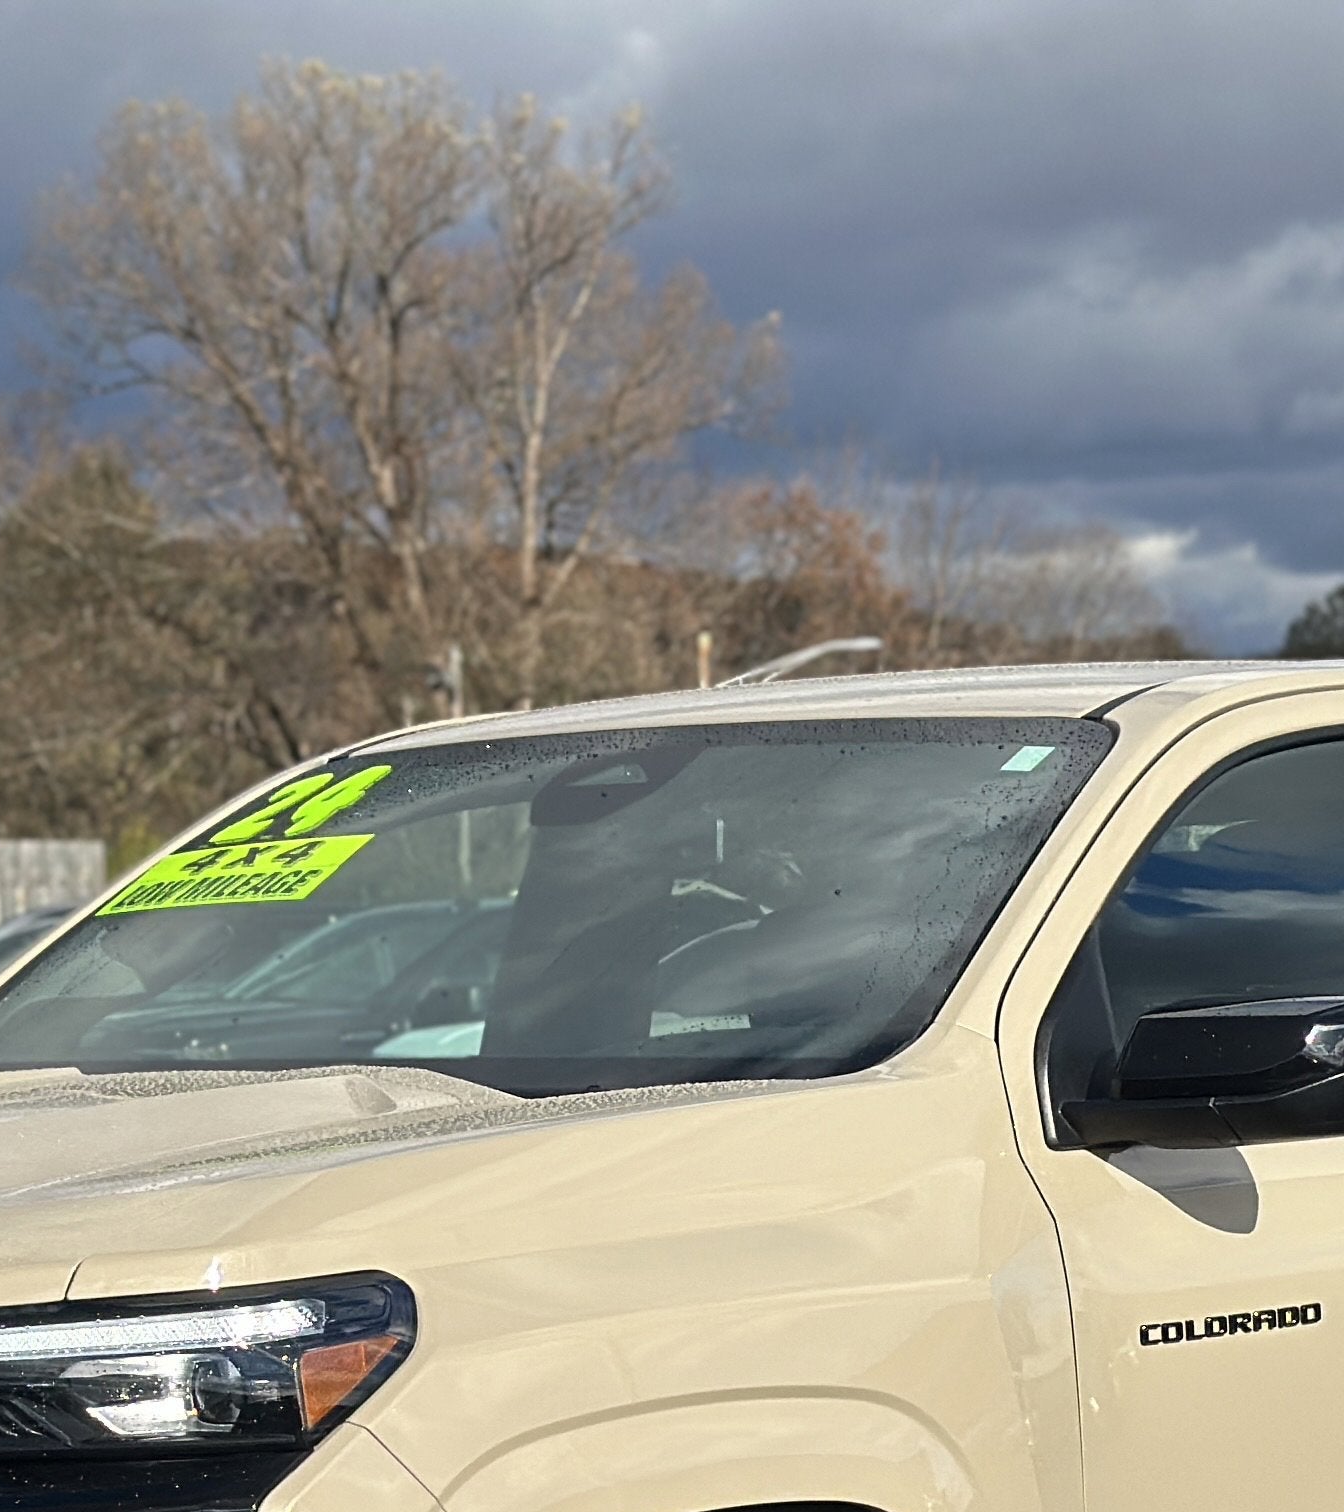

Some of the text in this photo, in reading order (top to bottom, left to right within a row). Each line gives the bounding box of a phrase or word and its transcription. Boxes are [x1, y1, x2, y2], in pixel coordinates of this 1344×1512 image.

[208, 764, 392, 844] 24
[110, 869, 323, 912] LOW MILEAGE
[1139, 1302, 1322, 1346] COLORADO
